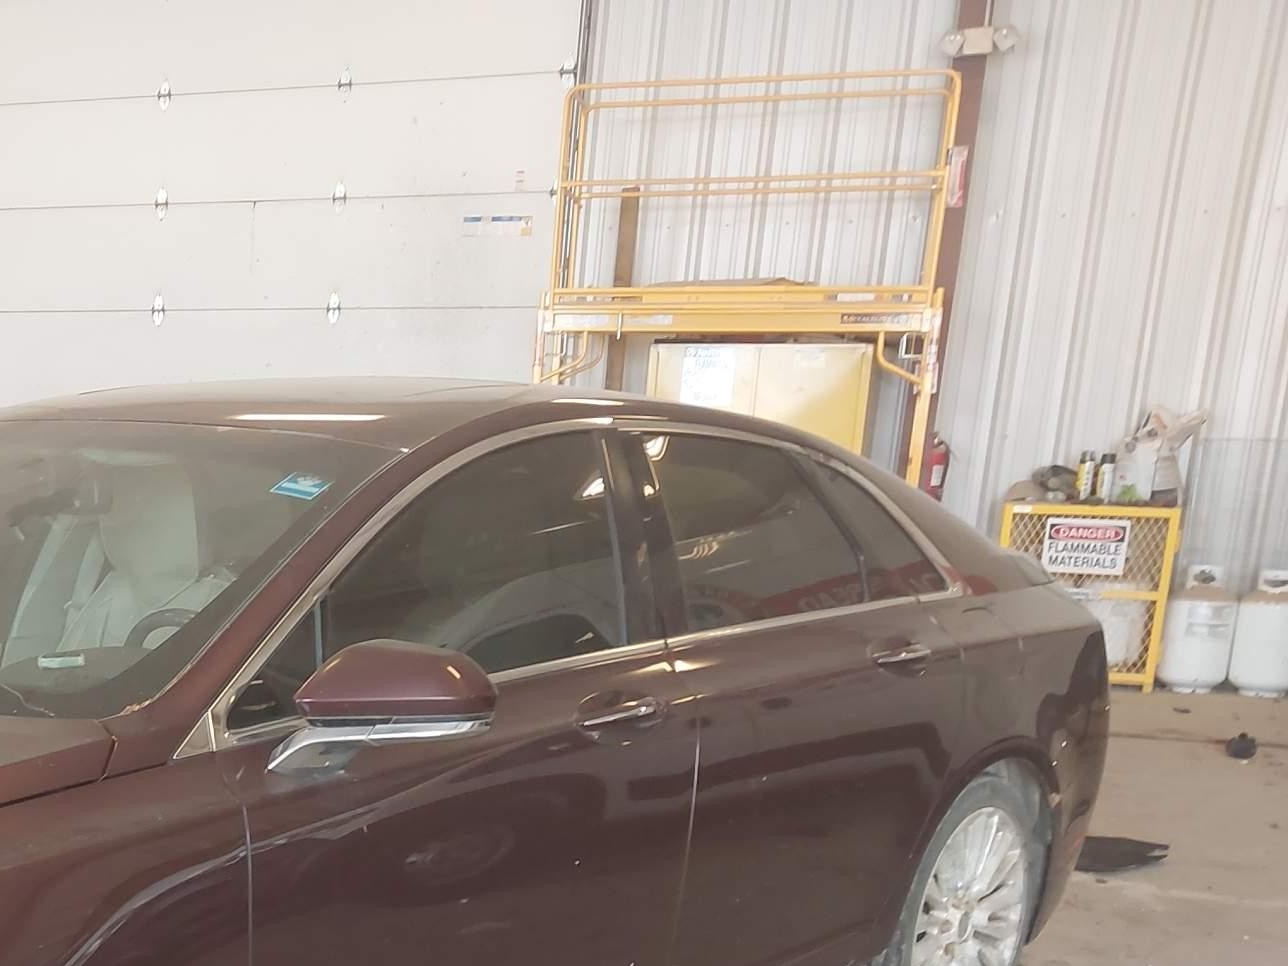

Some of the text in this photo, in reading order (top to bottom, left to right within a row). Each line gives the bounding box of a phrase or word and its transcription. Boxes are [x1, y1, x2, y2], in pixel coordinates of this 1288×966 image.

[1060, 527, 1115, 539] DANGER
[1048, 541, 1121, 556] FLAMMABLE
[1048, 555, 1117, 569] MATERIALS
